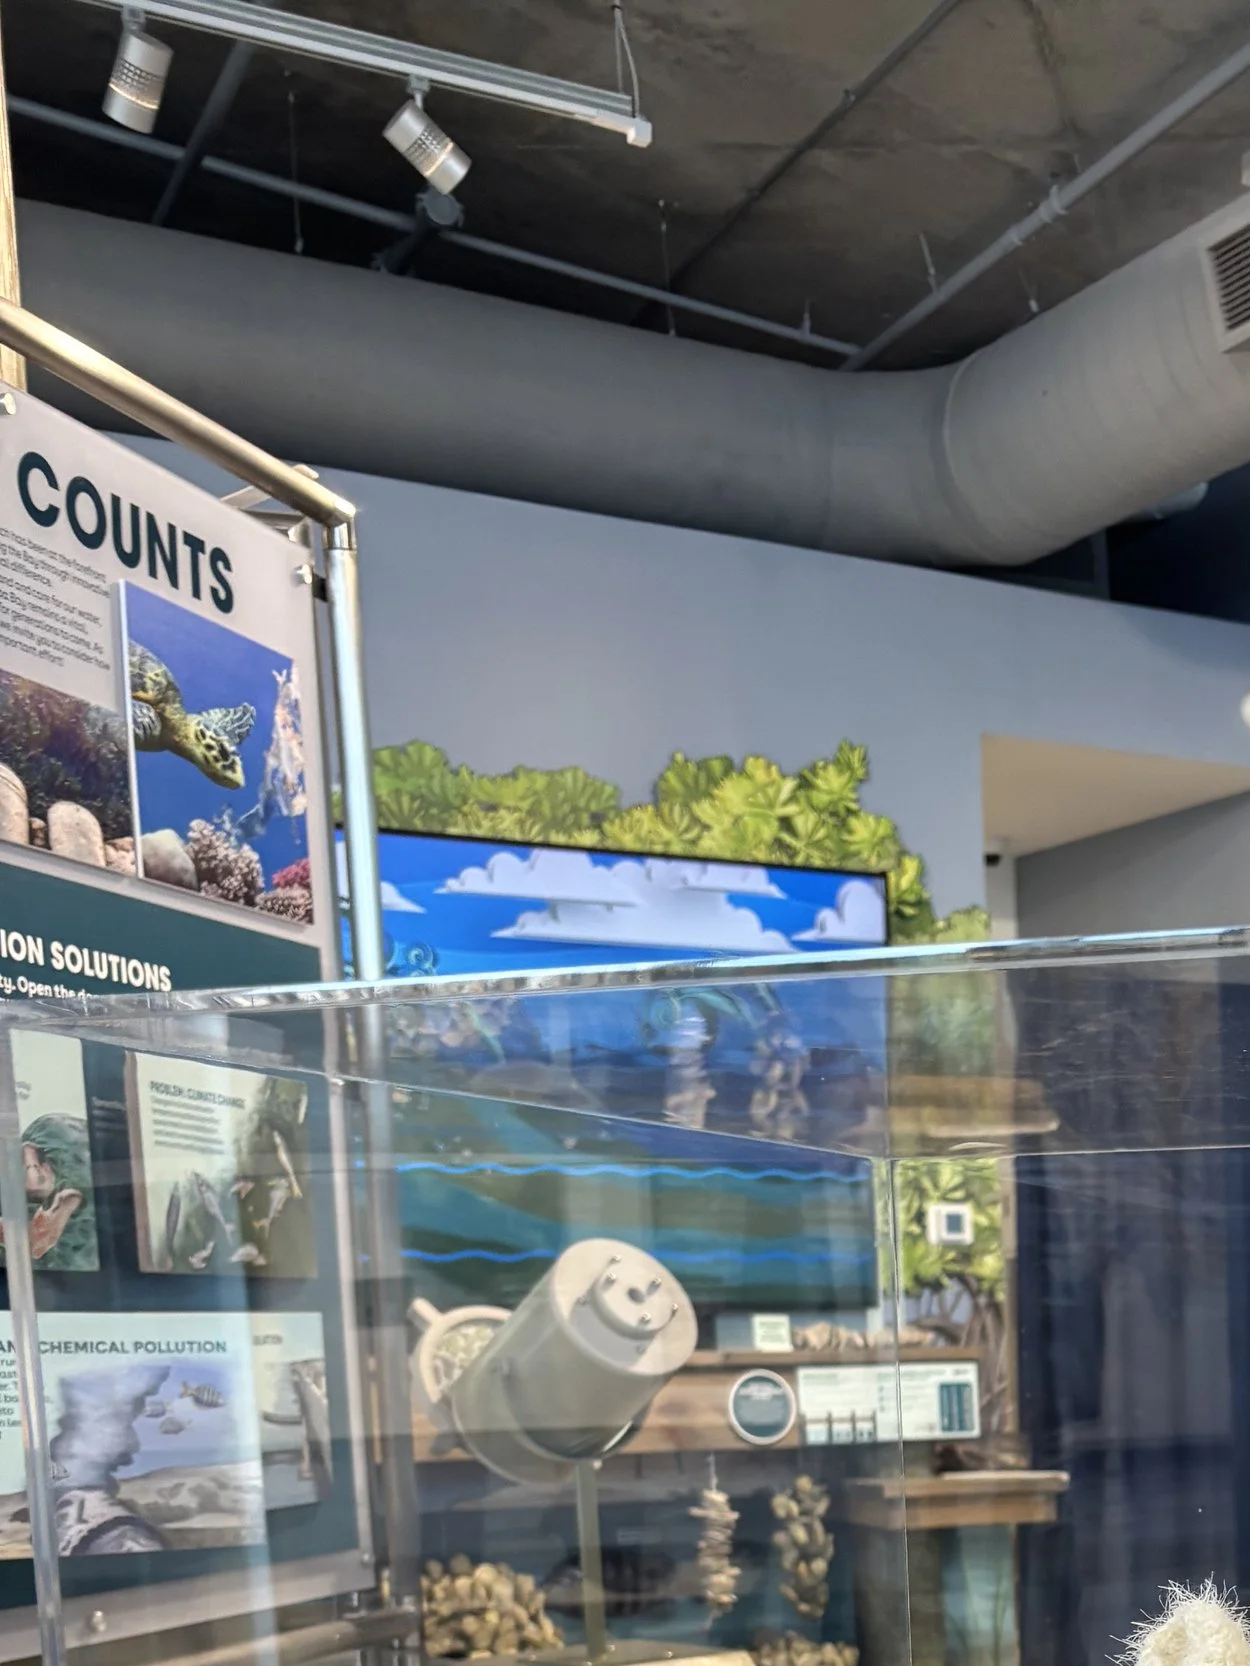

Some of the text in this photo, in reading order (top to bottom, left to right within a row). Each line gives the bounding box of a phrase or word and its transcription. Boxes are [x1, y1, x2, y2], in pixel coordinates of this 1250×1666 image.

[17, 451, 234, 614] COUNTS
[0, 928, 172, 992] ION SOLUTIONS
[17, 976, 52, 998] Open
[53, 984, 76, 999] the
[39, 1341, 129, 1355] CHEMICAL
[134, 1340, 227, 1354] POLLUTION
